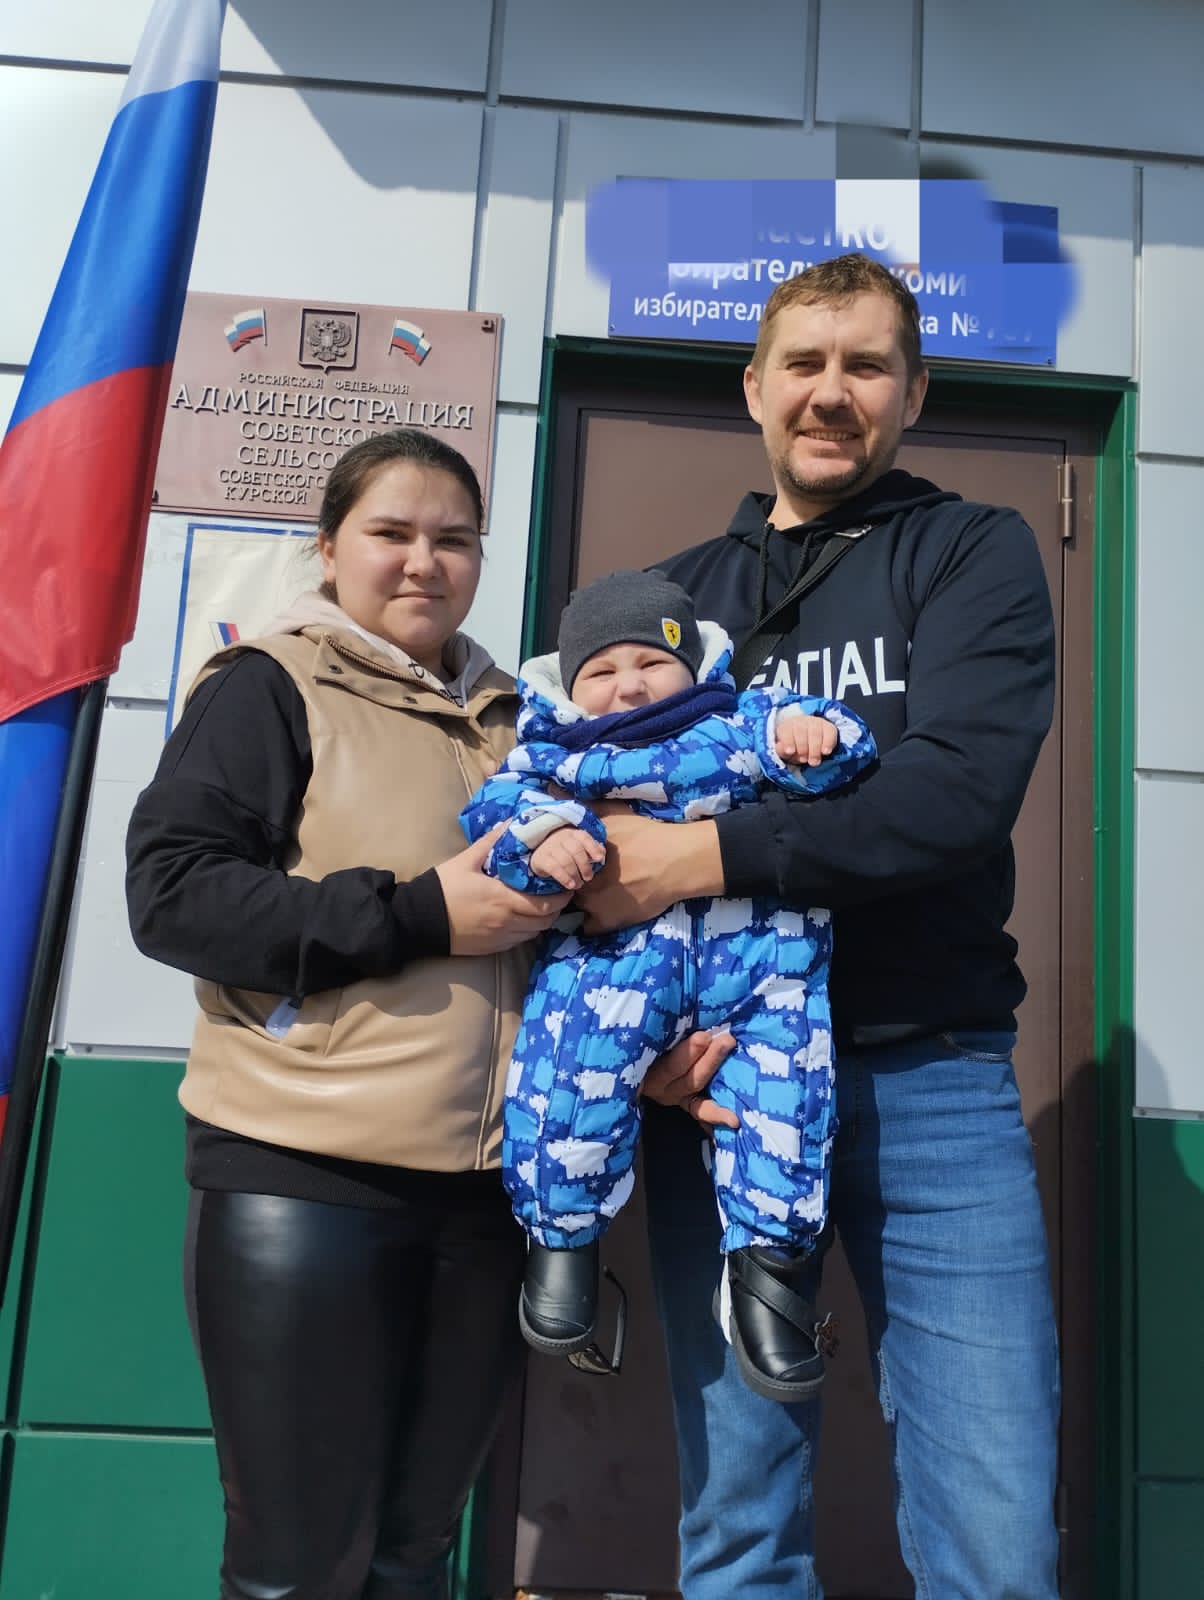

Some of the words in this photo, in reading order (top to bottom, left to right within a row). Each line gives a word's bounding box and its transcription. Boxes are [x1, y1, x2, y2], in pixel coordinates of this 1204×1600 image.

[634, 291, 767, 326] избирател
[239, 372, 325, 390] РОССИЙСКАЯ
[335, 380, 410, 395] ФЕДЕРАЦИЯ
[170, 383, 474, 431] АДМИНИСТРАЦИЯ
[238, 446, 343, 471] СЕЛЬСО
[219, 469, 327, 490] СОВЕТСКОГО
[224, 486, 308, 505] КУРСКОЙ
